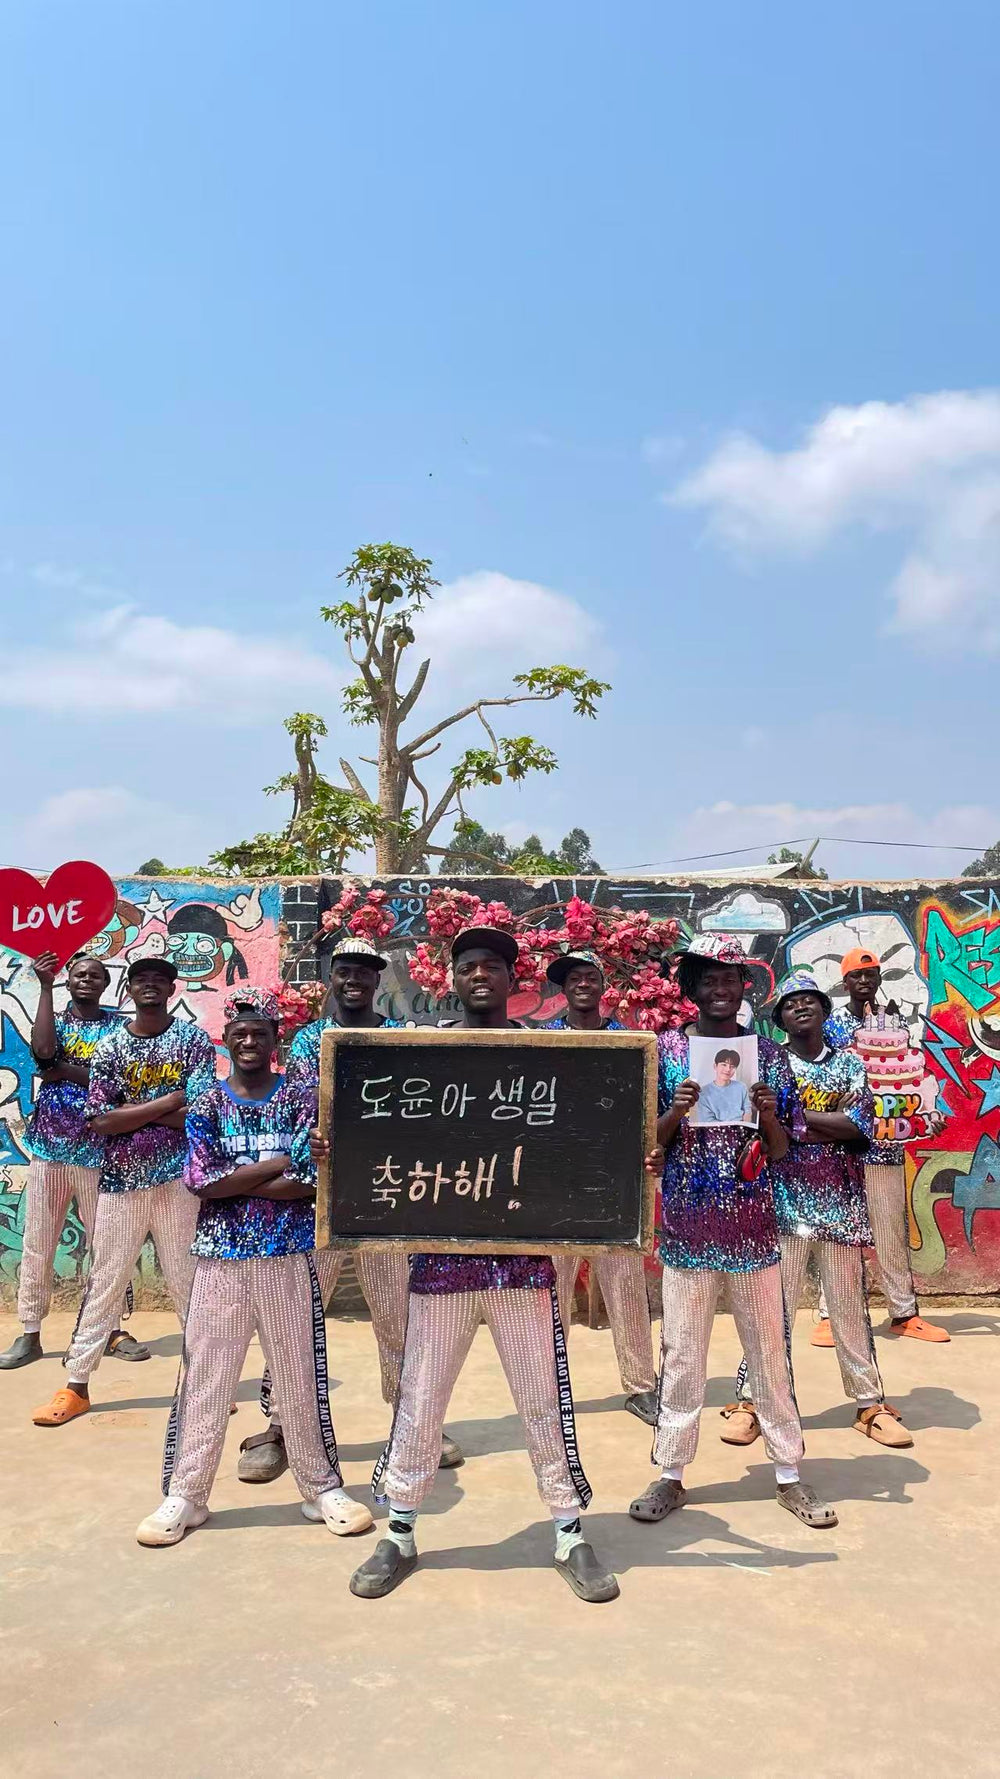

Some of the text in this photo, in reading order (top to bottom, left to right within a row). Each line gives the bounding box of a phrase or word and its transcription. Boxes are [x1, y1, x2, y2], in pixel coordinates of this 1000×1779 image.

[12, 899, 85, 932] LOVE
[63, 1033, 97, 1058] You
[124, 1061, 184, 1099] Young
[361, 1076, 557, 1125] 도윤아 생일
[873, 1094, 921, 1118] APPY
[220, 1135, 246, 1152] THE
[372, 1145, 523, 1210] 축하해!
[314, 1325, 326, 1350] LOVE
[554, 1327, 566, 1354] LOVE
[317, 1377, 328, 1401] LOVE
[559, 1384, 573, 1412] LOVE
[322, 1426, 335, 1447] LOVE
[565, 1442, 580, 1468] LOVE
